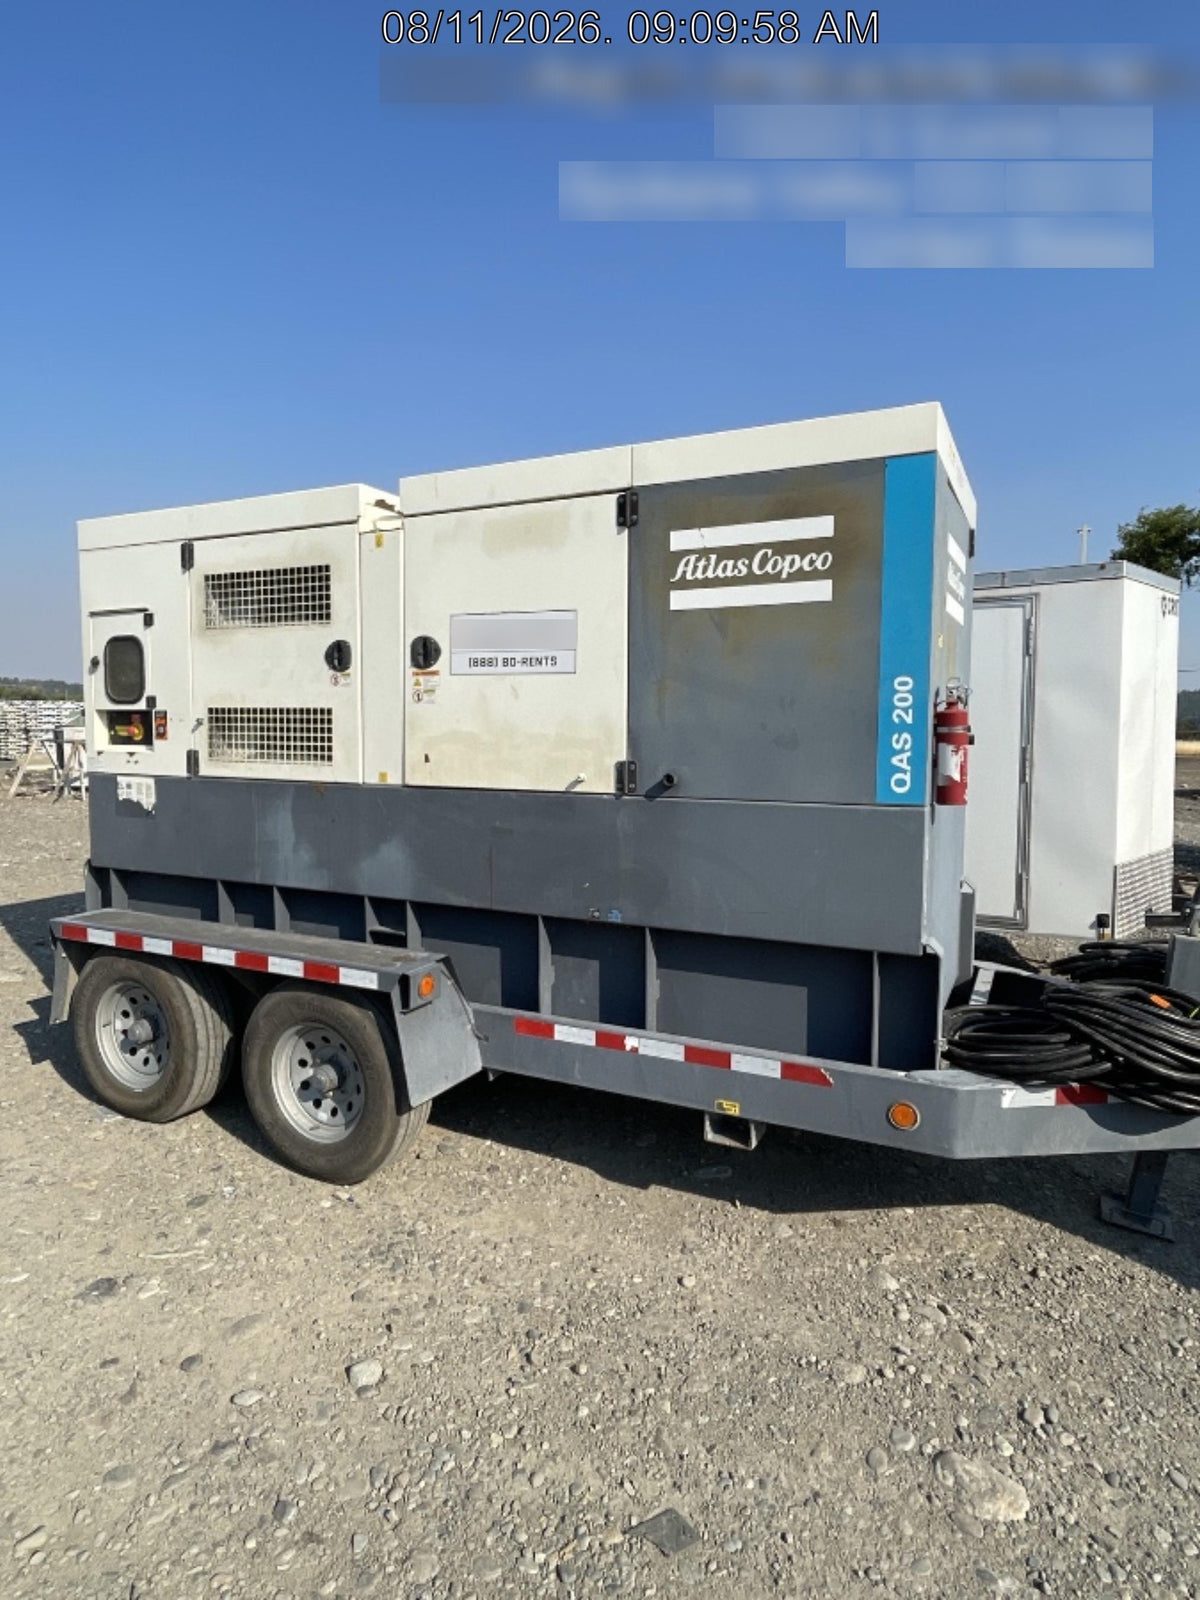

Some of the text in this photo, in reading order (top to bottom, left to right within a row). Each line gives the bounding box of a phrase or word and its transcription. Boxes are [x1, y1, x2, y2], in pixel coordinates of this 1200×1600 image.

[669, 548, 833, 582] Atlas Copco
[890, 675, 914, 794] QAS 200
